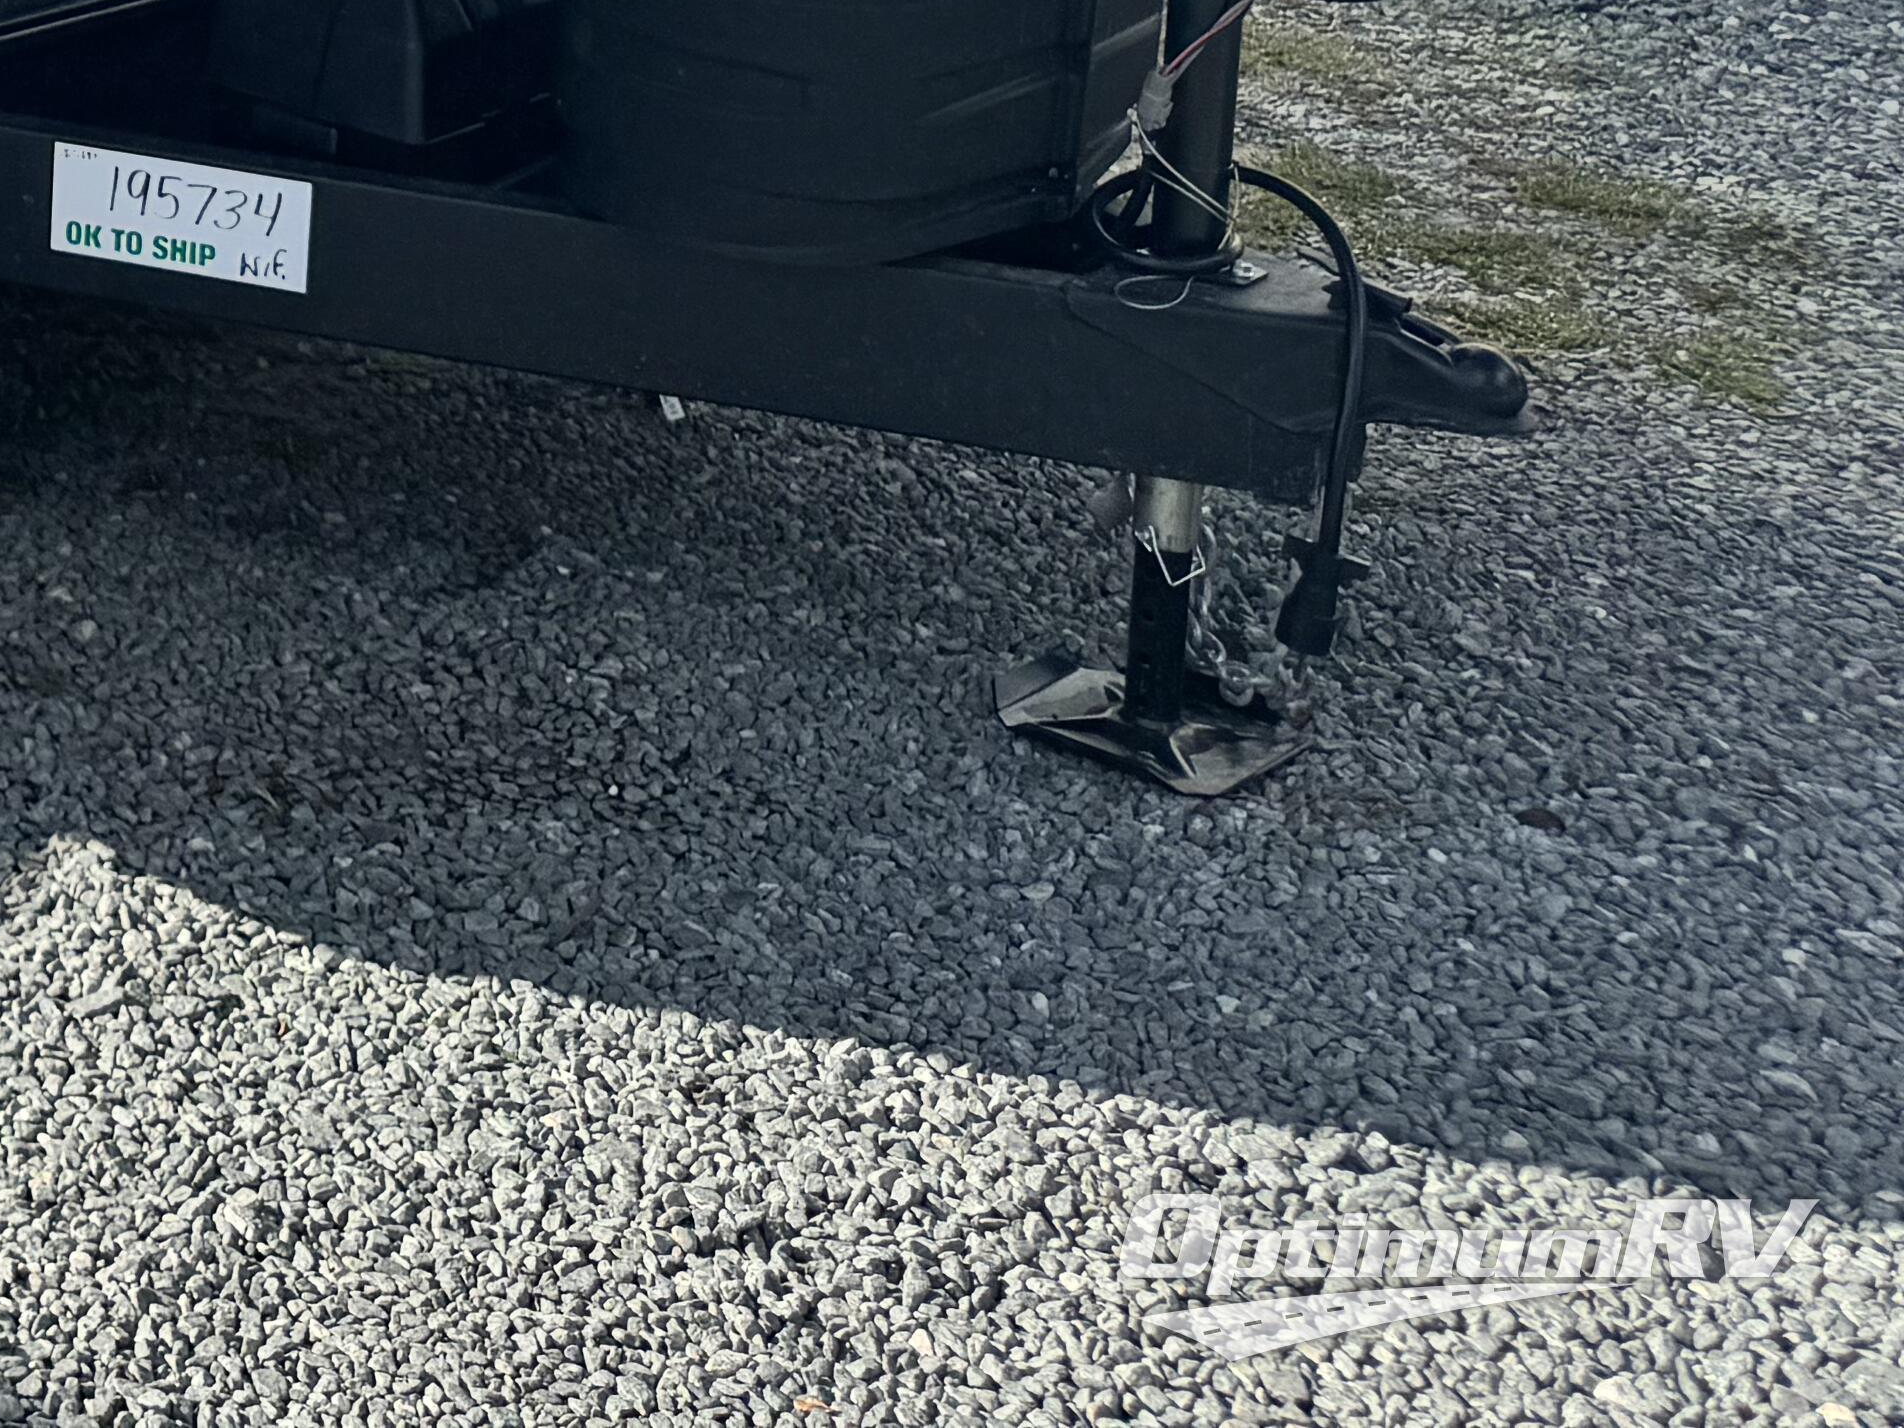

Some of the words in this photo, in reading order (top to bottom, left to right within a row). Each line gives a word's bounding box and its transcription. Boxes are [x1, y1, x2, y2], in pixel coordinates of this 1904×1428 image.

[109, 166, 283, 236] 195734
[65, 220, 102, 248] OK
[110, 227, 142, 255] TO
[152, 235, 216, 266] SHIP
